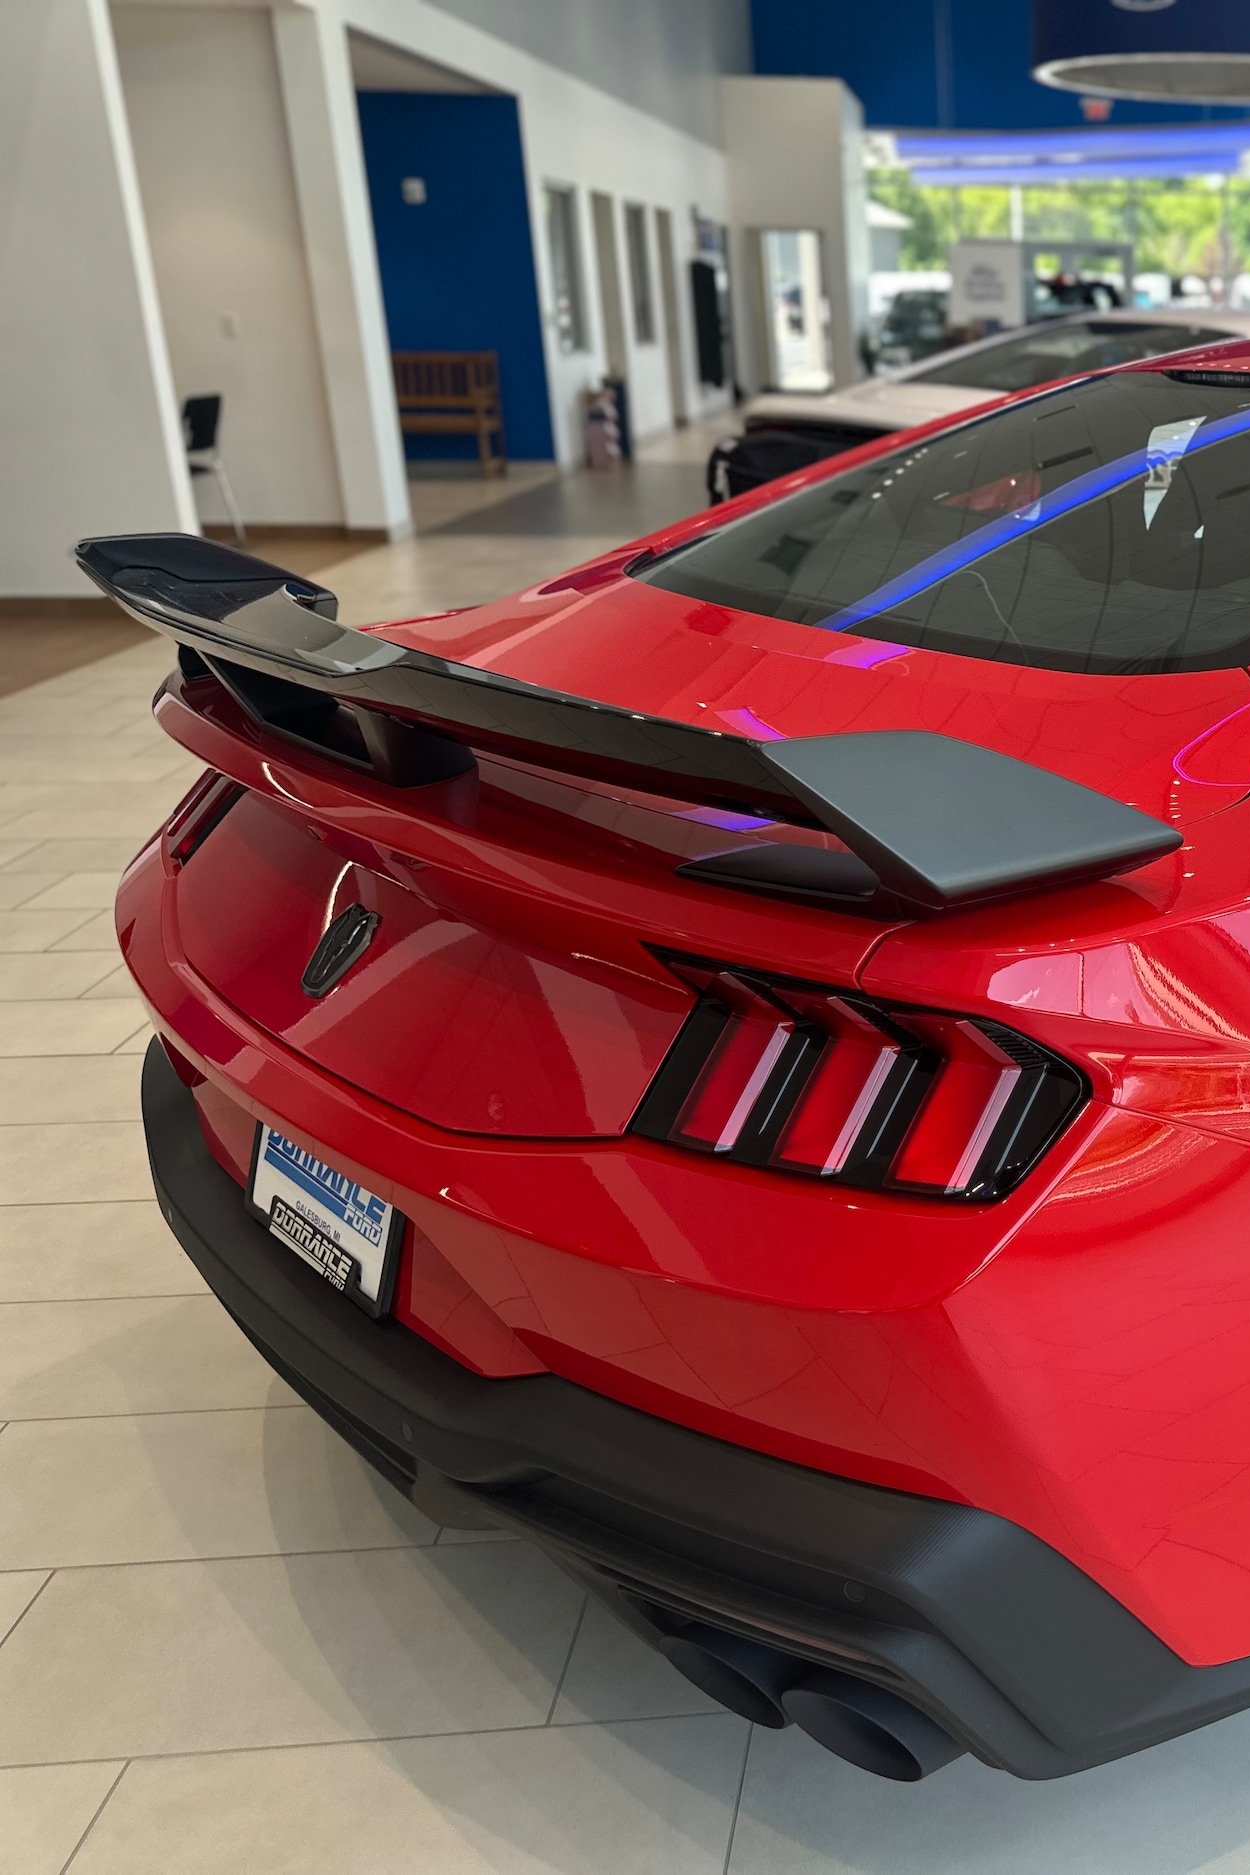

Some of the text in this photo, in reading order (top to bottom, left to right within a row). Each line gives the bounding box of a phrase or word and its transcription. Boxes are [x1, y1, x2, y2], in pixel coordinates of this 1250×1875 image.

[295, 1200, 332, 1239] GALESBURG,
[343, 1203, 383, 1245] FORD
[271, 1201, 353, 1281] DORRANCE
